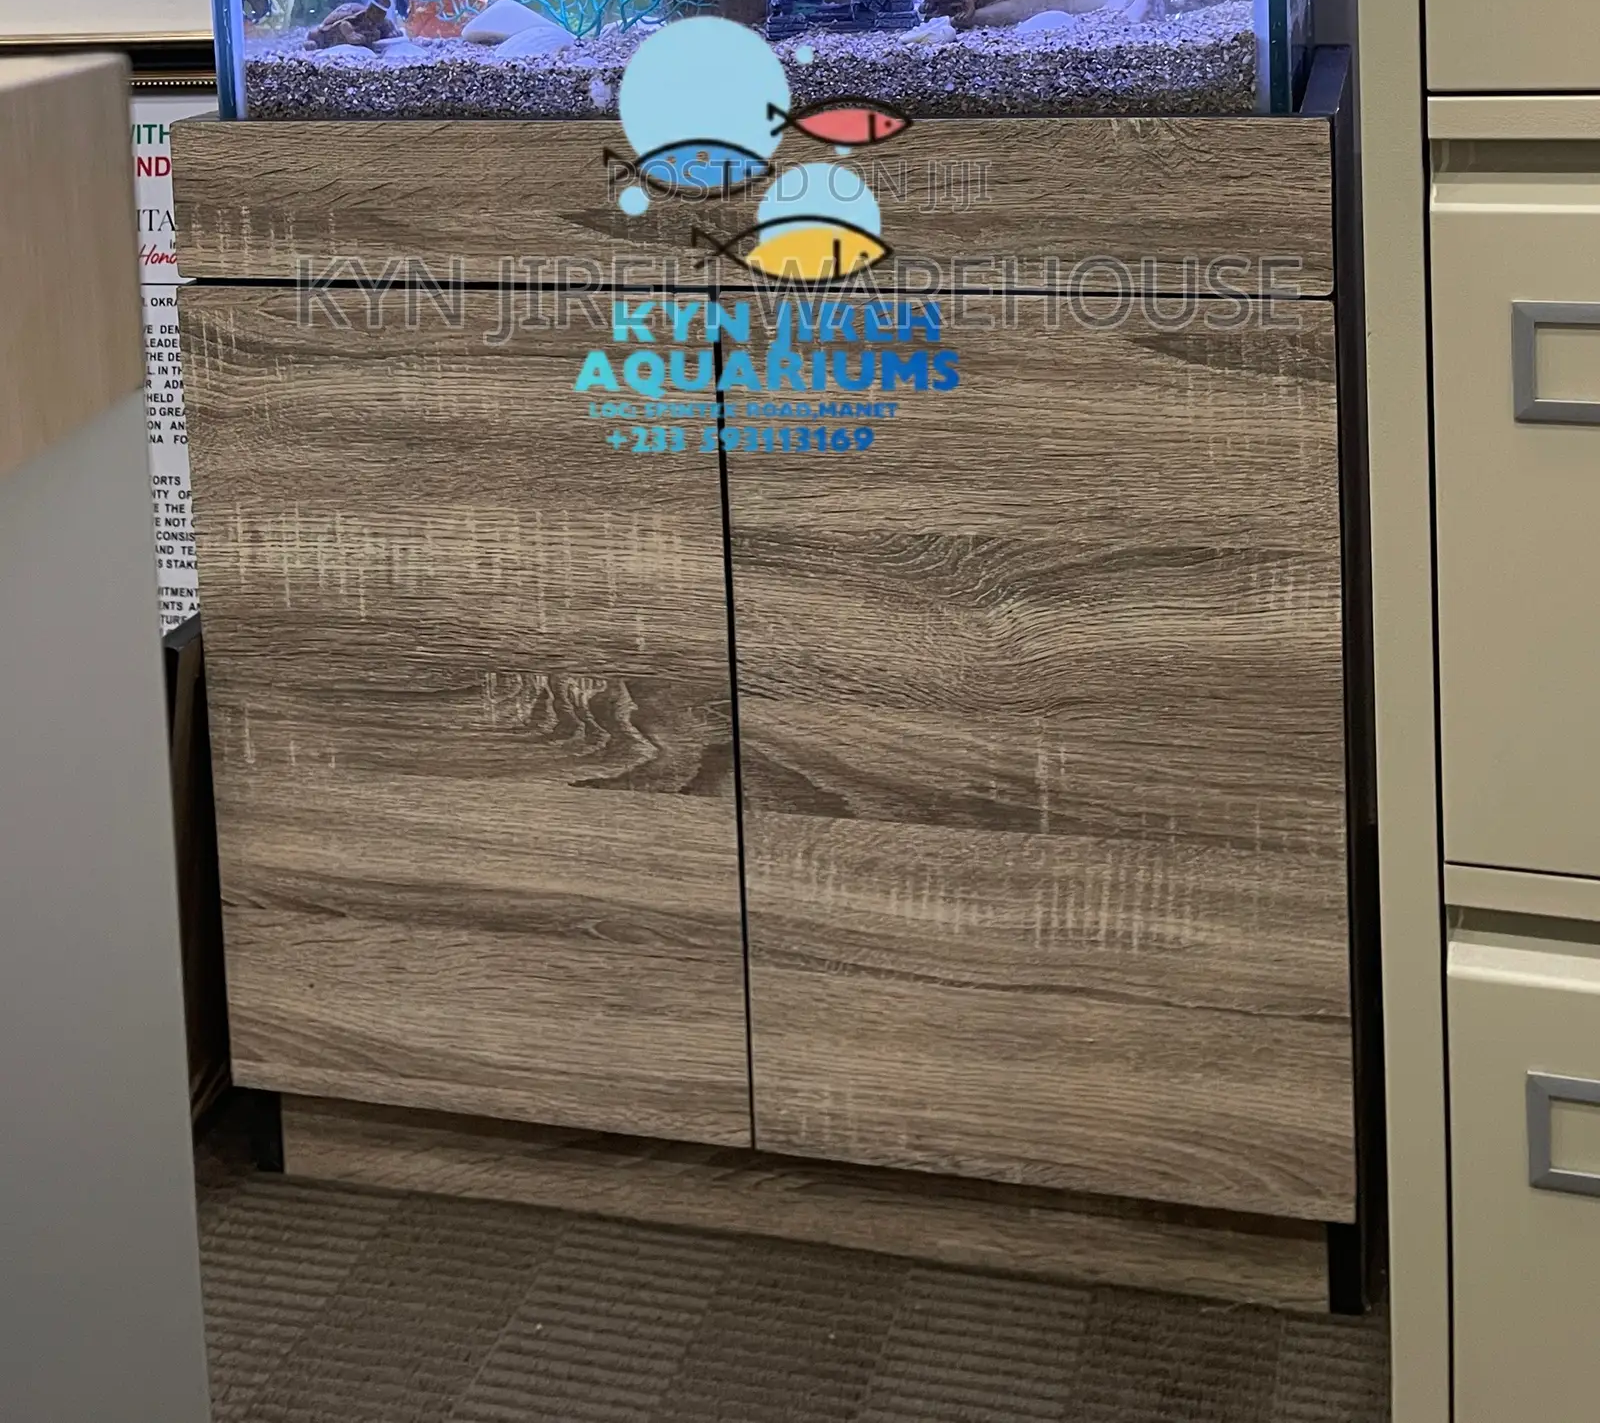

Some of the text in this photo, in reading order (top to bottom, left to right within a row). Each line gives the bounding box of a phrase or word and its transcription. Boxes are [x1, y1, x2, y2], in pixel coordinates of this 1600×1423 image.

[132, 124, 170, 145] ITH
[165, 503, 186, 514] THE
[165, 518, 186, 527] NOT
